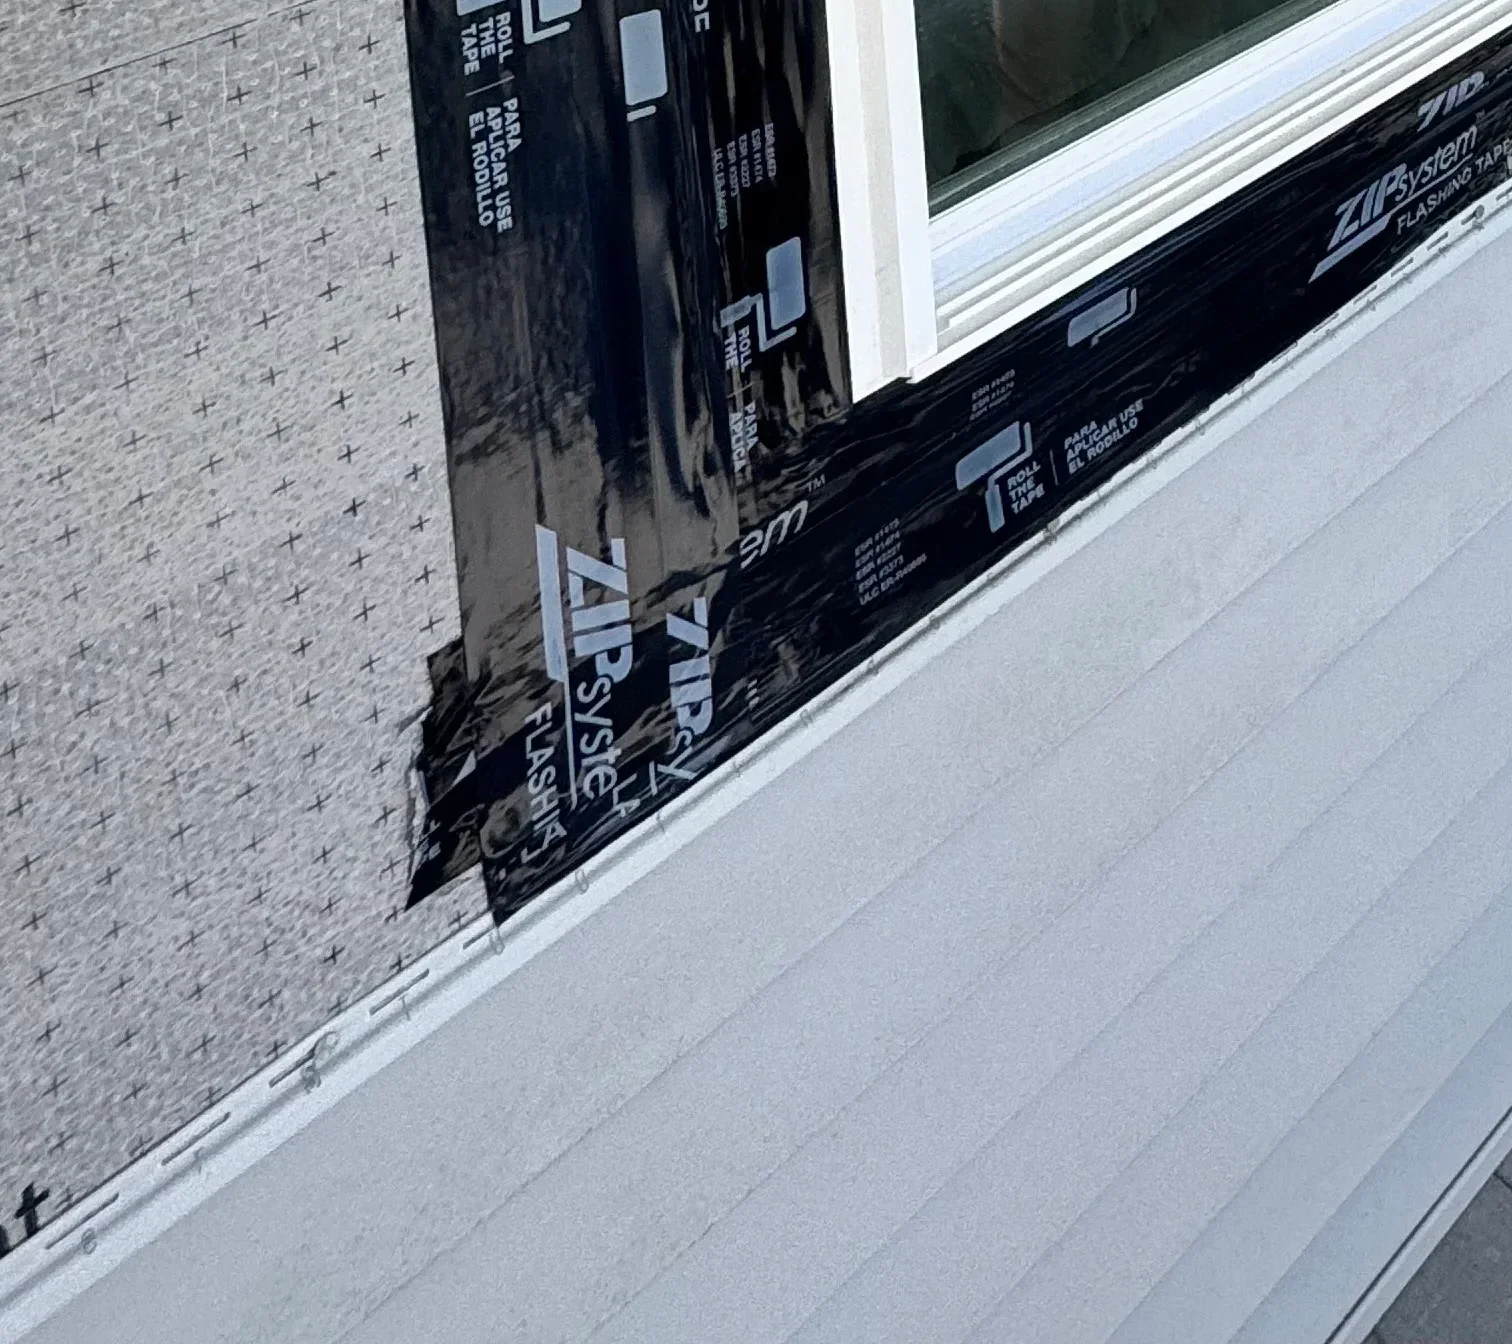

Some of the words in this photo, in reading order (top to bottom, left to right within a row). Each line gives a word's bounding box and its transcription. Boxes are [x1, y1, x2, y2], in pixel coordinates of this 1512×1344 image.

[460, 24, 481, 76] TAPE
[478, 17, 496, 60] THE
[494, 11, 516, 64] ROLL
[467, 111, 479, 139] EL
[486, 106, 510, 192] APLICAR
[503, 97, 524, 154] PARA
[470, 144, 496, 228] RODILLO
[1397, 166, 1473, 236] FLASHING
[1474, 137, 1511, 172] TAPE
[492, 193, 514, 234] USE
[724, 331, 739, 371] THE
[738, 325, 753, 373] ROLL
[744, 399, 759, 452] PARA
[1063, 420, 1099, 450] PARA
[1065, 416, 1118, 463] APLICAR
[1119, 399, 1144, 423] USE
[1068, 457, 1086, 475] EL
[1086, 417, 1139, 460] RODILLO
[1007, 461, 1041, 489] ROLL
[1008, 476, 1037, 502] THE
[1010, 482, 1045, 515] TAPE
